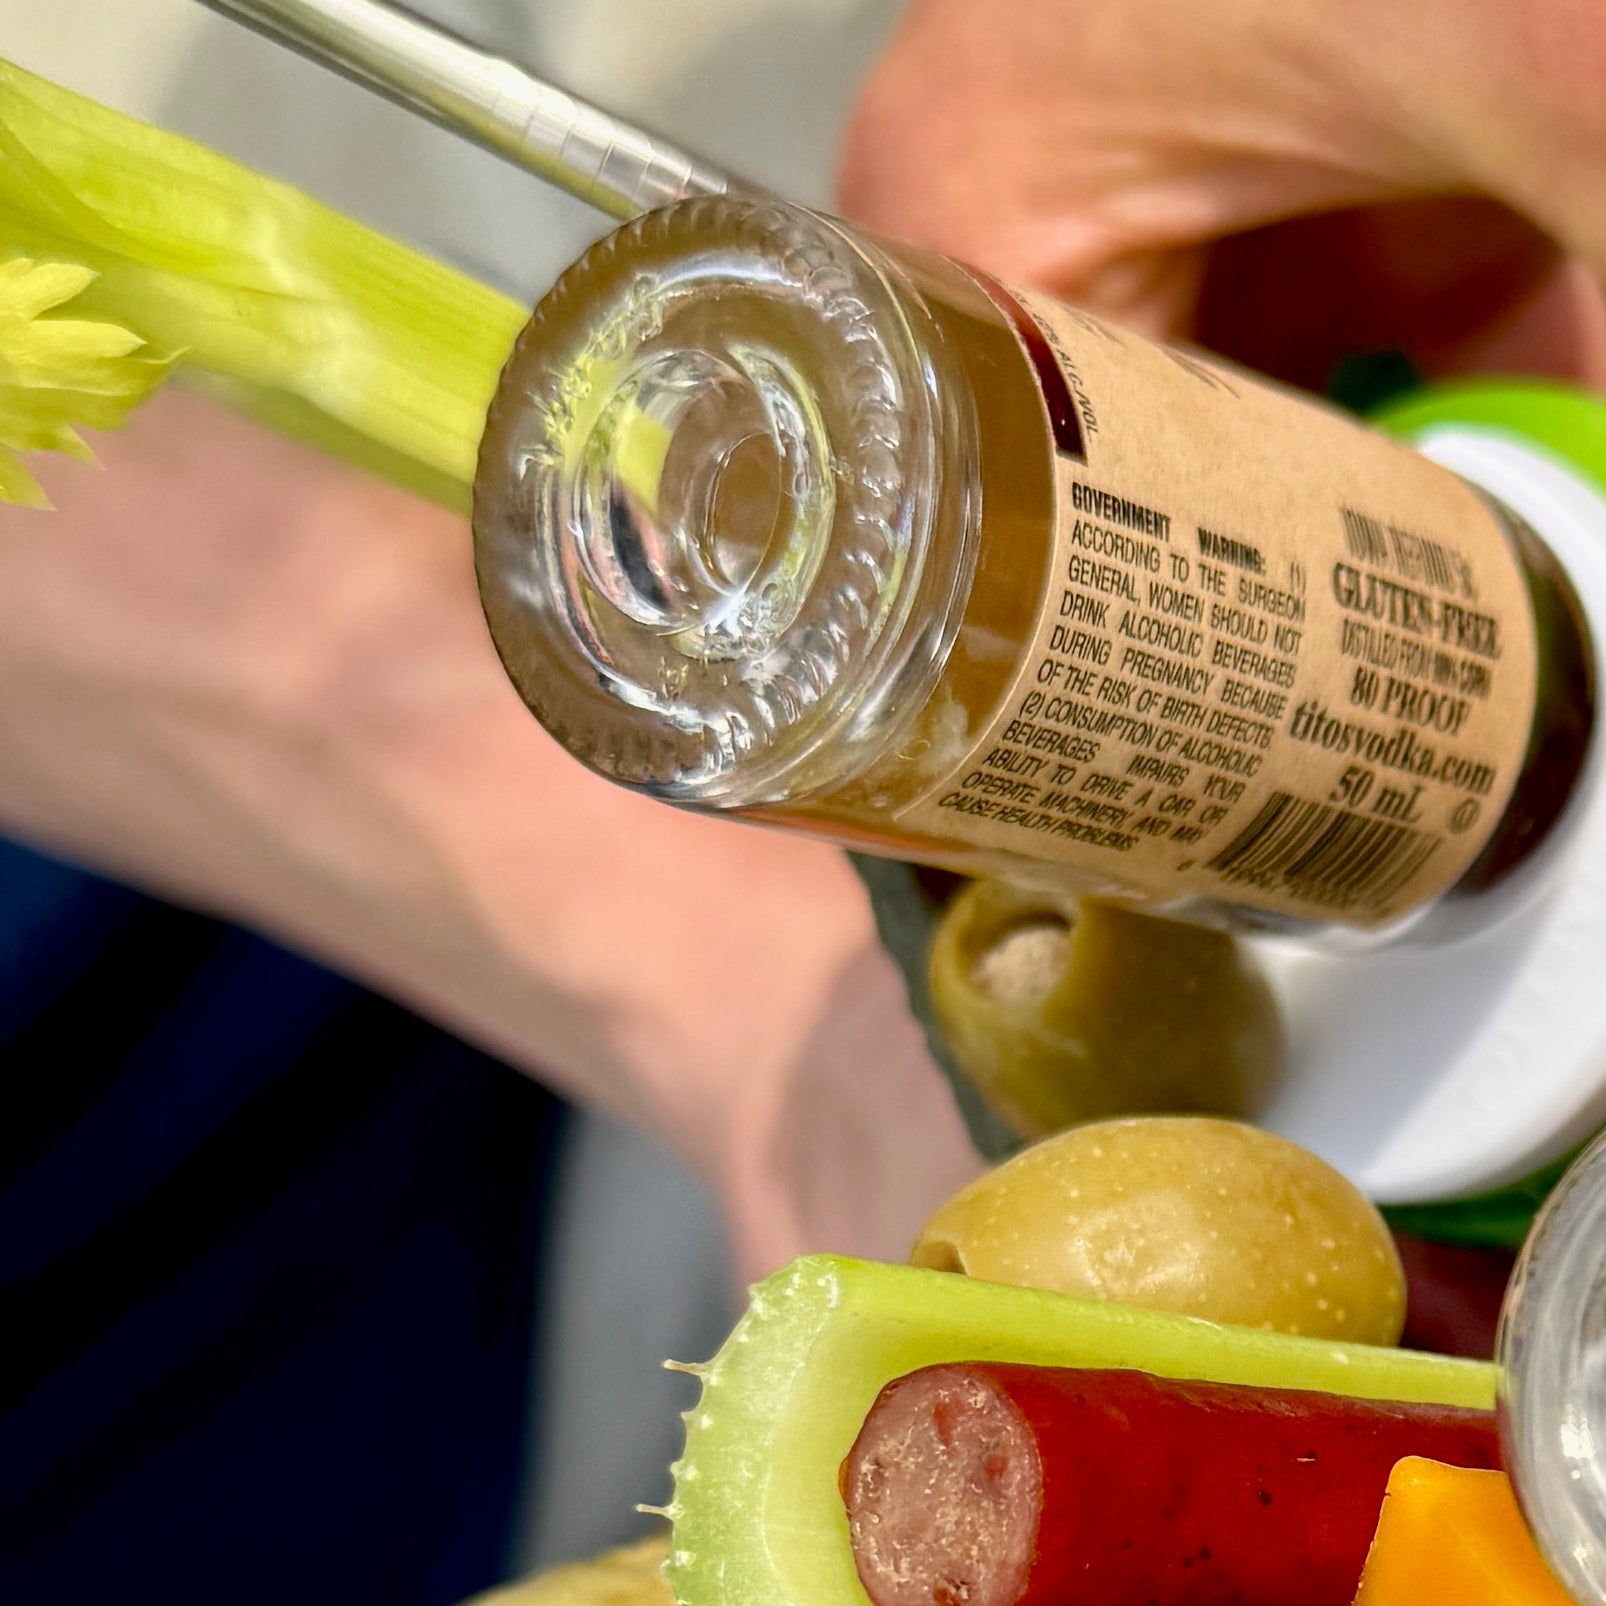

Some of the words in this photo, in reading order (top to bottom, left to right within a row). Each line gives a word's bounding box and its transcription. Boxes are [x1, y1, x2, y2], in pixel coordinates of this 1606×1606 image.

[1072, 481, 1171, 543] GOVERNMENT
[1198, 527, 1266, 576] WARNING:
[1072, 519, 1161, 574] ACCORDING
[1169, 553, 1190, 583] TO
[1198, 564, 1227, 596] THE
[1239, 577, 1307, 623] SURGEON
[1060, 590, 1110, 629] DRINK
[1118, 610, 1203, 657] ALCOHOLIC
[1212, 639, 1295, 689] BEVERAGES
[1069, 554, 1141, 607] GENERAL,
[1149, 582, 1205, 624] WOMEN
[1211, 603, 1268, 645] SHOULD
[1274, 625, 1304, 656] NOT
[1331, 561, 1502, 661] GLUTEN-FREE
[1037, 658, 1062, 685] OF
[1065, 665, 1093, 698] THE
[1096, 676, 1134, 708] RISK
[1136, 687, 1162, 716] OF
[1161, 696, 1209, 730] BIRTH
[1050, 625, 1112, 665] DURING
[1120, 647, 1215, 698] PREGNANCY
[1220, 678, 1290, 721] BECAUSE
[1350, 665, 1380, 711] 80
[1380, 675, 1472, 737] PROOF
[1002, 719, 1100, 763] BEVERAGES
[1125, 753, 1191, 788] IMPAIRS
[1202, 773, 1248, 805] YOUR
[1019, 690, 1044, 721] (2)
[1045, 696, 1156, 750] CONSUMPTION
[1154, 728, 1182, 754] OF
[1178, 736, 1264, 778] ALCOHOLIC
[1289, 699, 1498, 796] titosvodka.com
[938, 792, 1001, 820] CAUSE
[998, 805, 1061, 835] HEALTH
[960, 772, 1042, 804] OPERATE
[982, 747, 1049, 780] ABILITY
[1050, 764, 1077, 786] TO
[1080, 774, 1133, 801] DRIVE
[1133, 788, 1155, 808] A
[1157, 794, 1196, 818] CAR
[1199, 804, 1230, 827] OR
[1328, 764, 1376, 809] 50
[1372, 783, 1427, 825] mL
